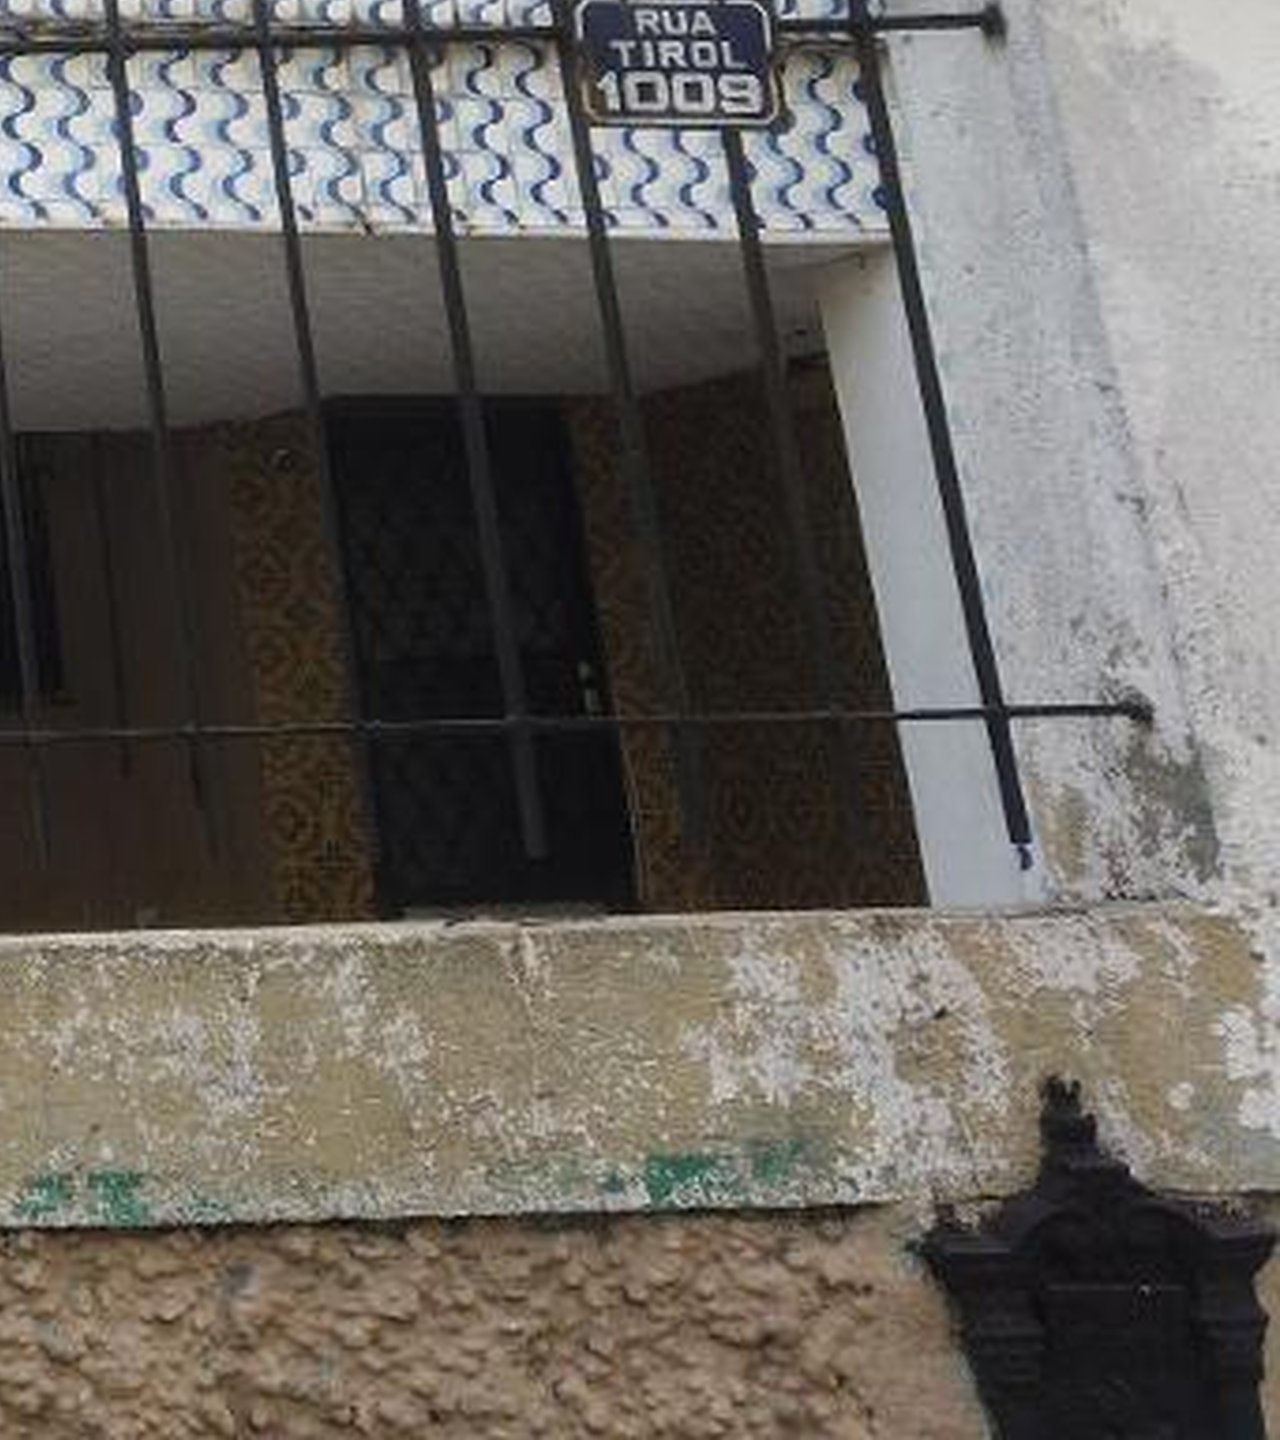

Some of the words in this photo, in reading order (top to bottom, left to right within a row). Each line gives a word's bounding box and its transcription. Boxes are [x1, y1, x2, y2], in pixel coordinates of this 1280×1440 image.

[635, 10, 716, 36] RUA
[609, 40, 747, 69] TIROL
[596, 70, 763, 114] 1009
